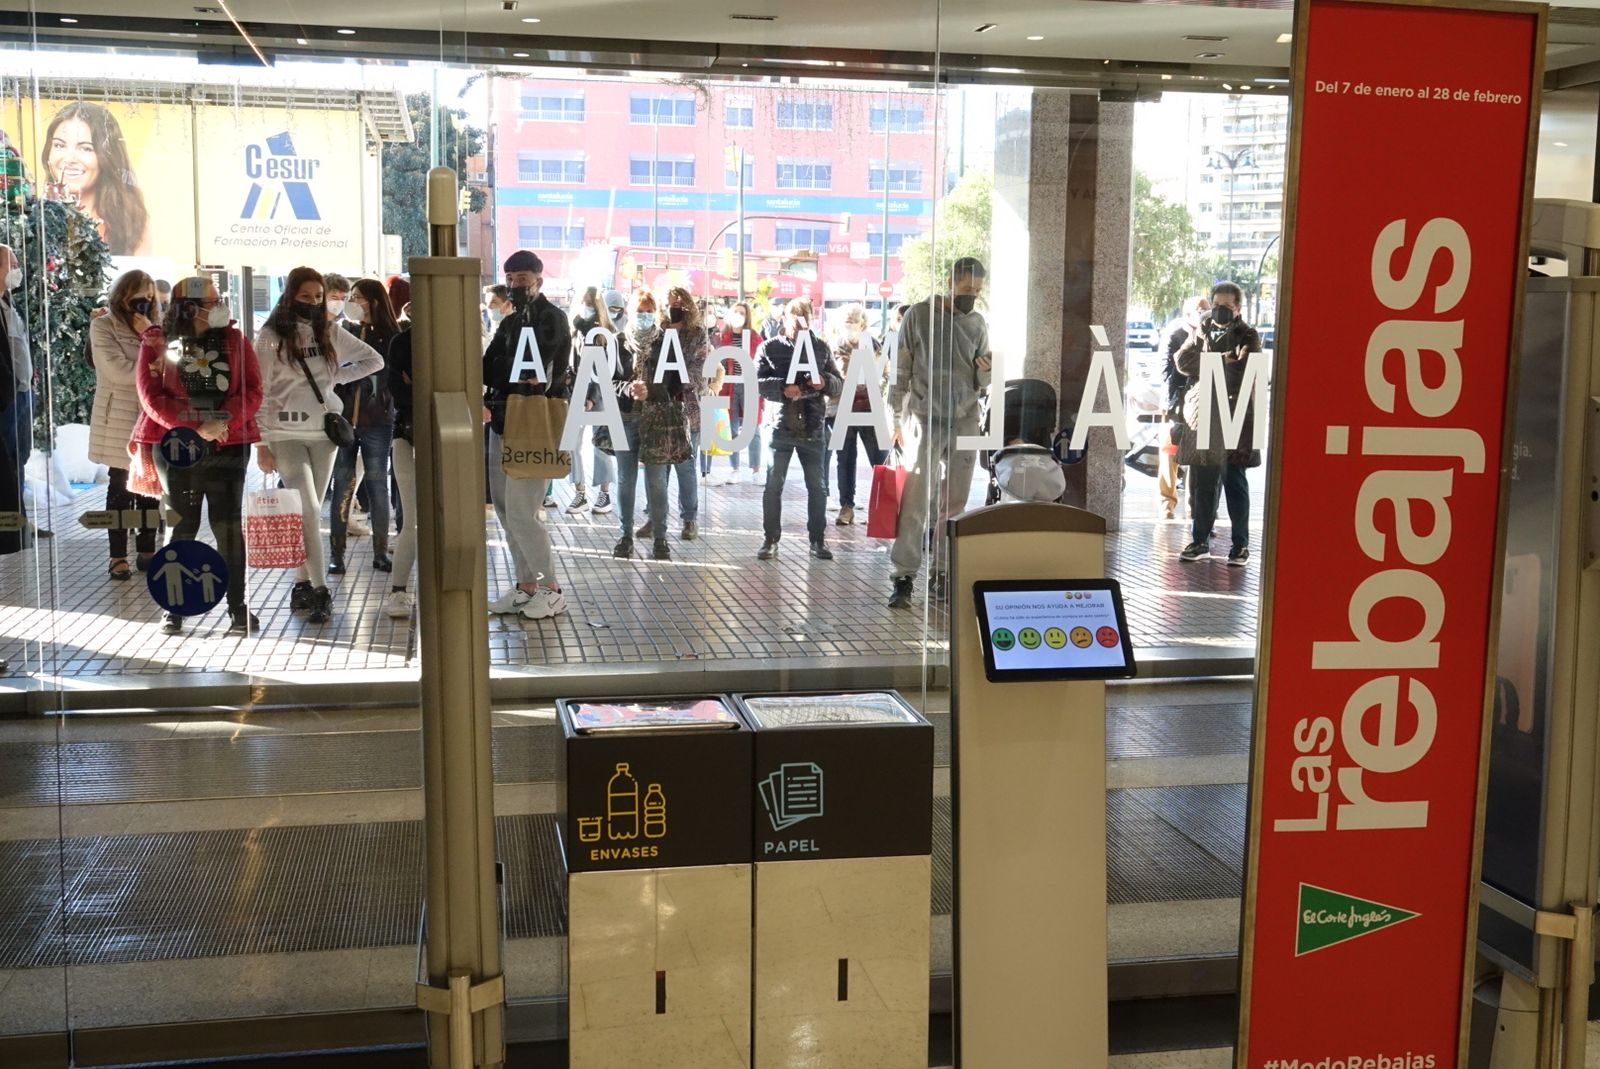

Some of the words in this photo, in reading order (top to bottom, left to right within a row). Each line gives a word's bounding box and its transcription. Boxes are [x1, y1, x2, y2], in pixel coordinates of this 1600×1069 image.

[1315, 80, 1338, 94] Del
[1342, 82, 1351, 94] 7
[1354, 82, 1372, 95] de
[1375, 86, 1415, 98] enero
[1417, 86, 1430, 99] al
[1433, 87, 1450, 100] 28
[1453, 88, 1471, 101] de
[1474, 89, 1522, 104] febrero
[245, 143, 321, 180] Cesur
[230, 223, 270, 234] Centro
[274, 225, 313, 236] Oficial
[315, 226, 332, 236] de
[280, 238, 349, 250] Profesional
[830, 244, 849, 253] VSA
[1311, 217, 1486, 832] rebajas
[1273, 716, 1335, 832] Las
[590, 845, 659, 861] ENVASES
[763, 839, 820, 854] PAPEL
[1303, 909, 1316, 924] El
[1317, 910, 1347, 924] Corte
[1347, 905, 1392, 928] Inglés
[1263, 1052, 1436, 1069] #ModoRebajas
